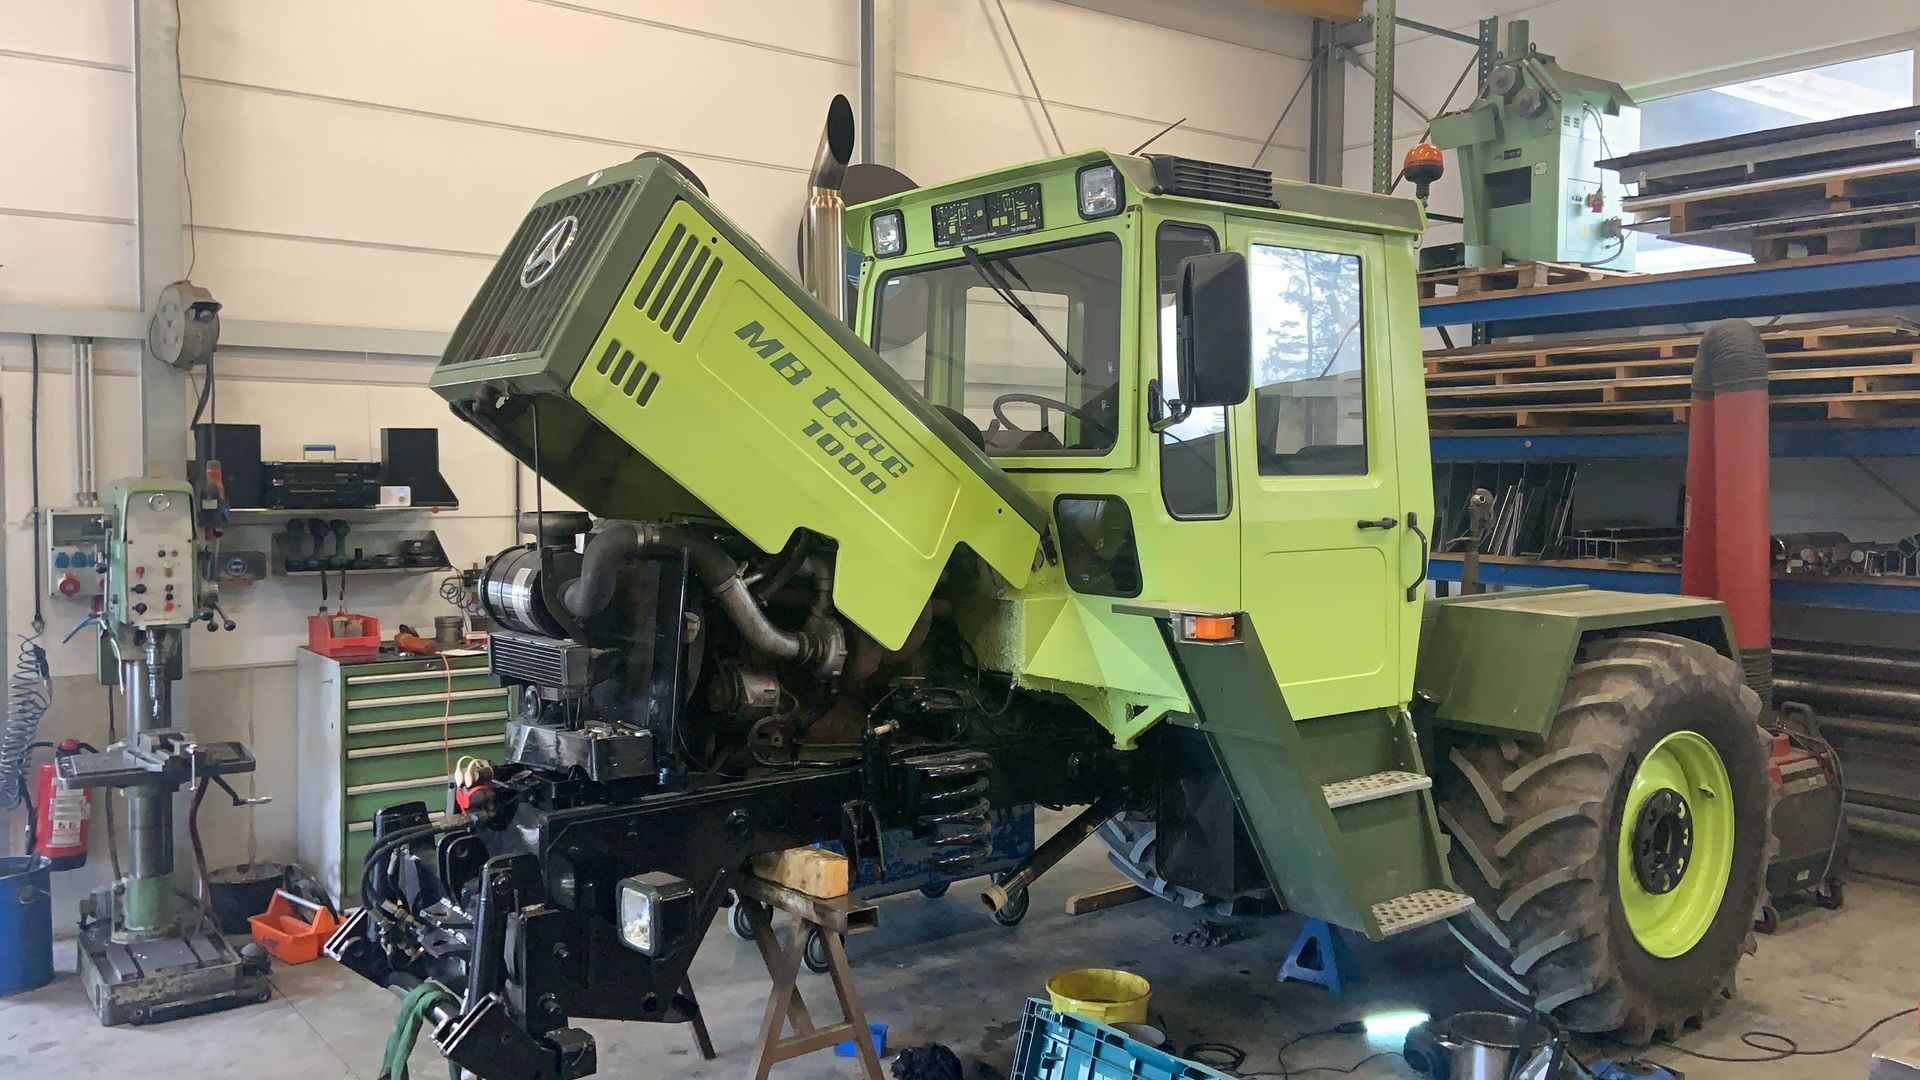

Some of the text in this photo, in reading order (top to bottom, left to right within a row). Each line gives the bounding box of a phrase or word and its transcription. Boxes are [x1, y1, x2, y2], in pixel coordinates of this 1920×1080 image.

[734, 320, 914, 478] MB trac
[802, 419, 887, 495] 1000
